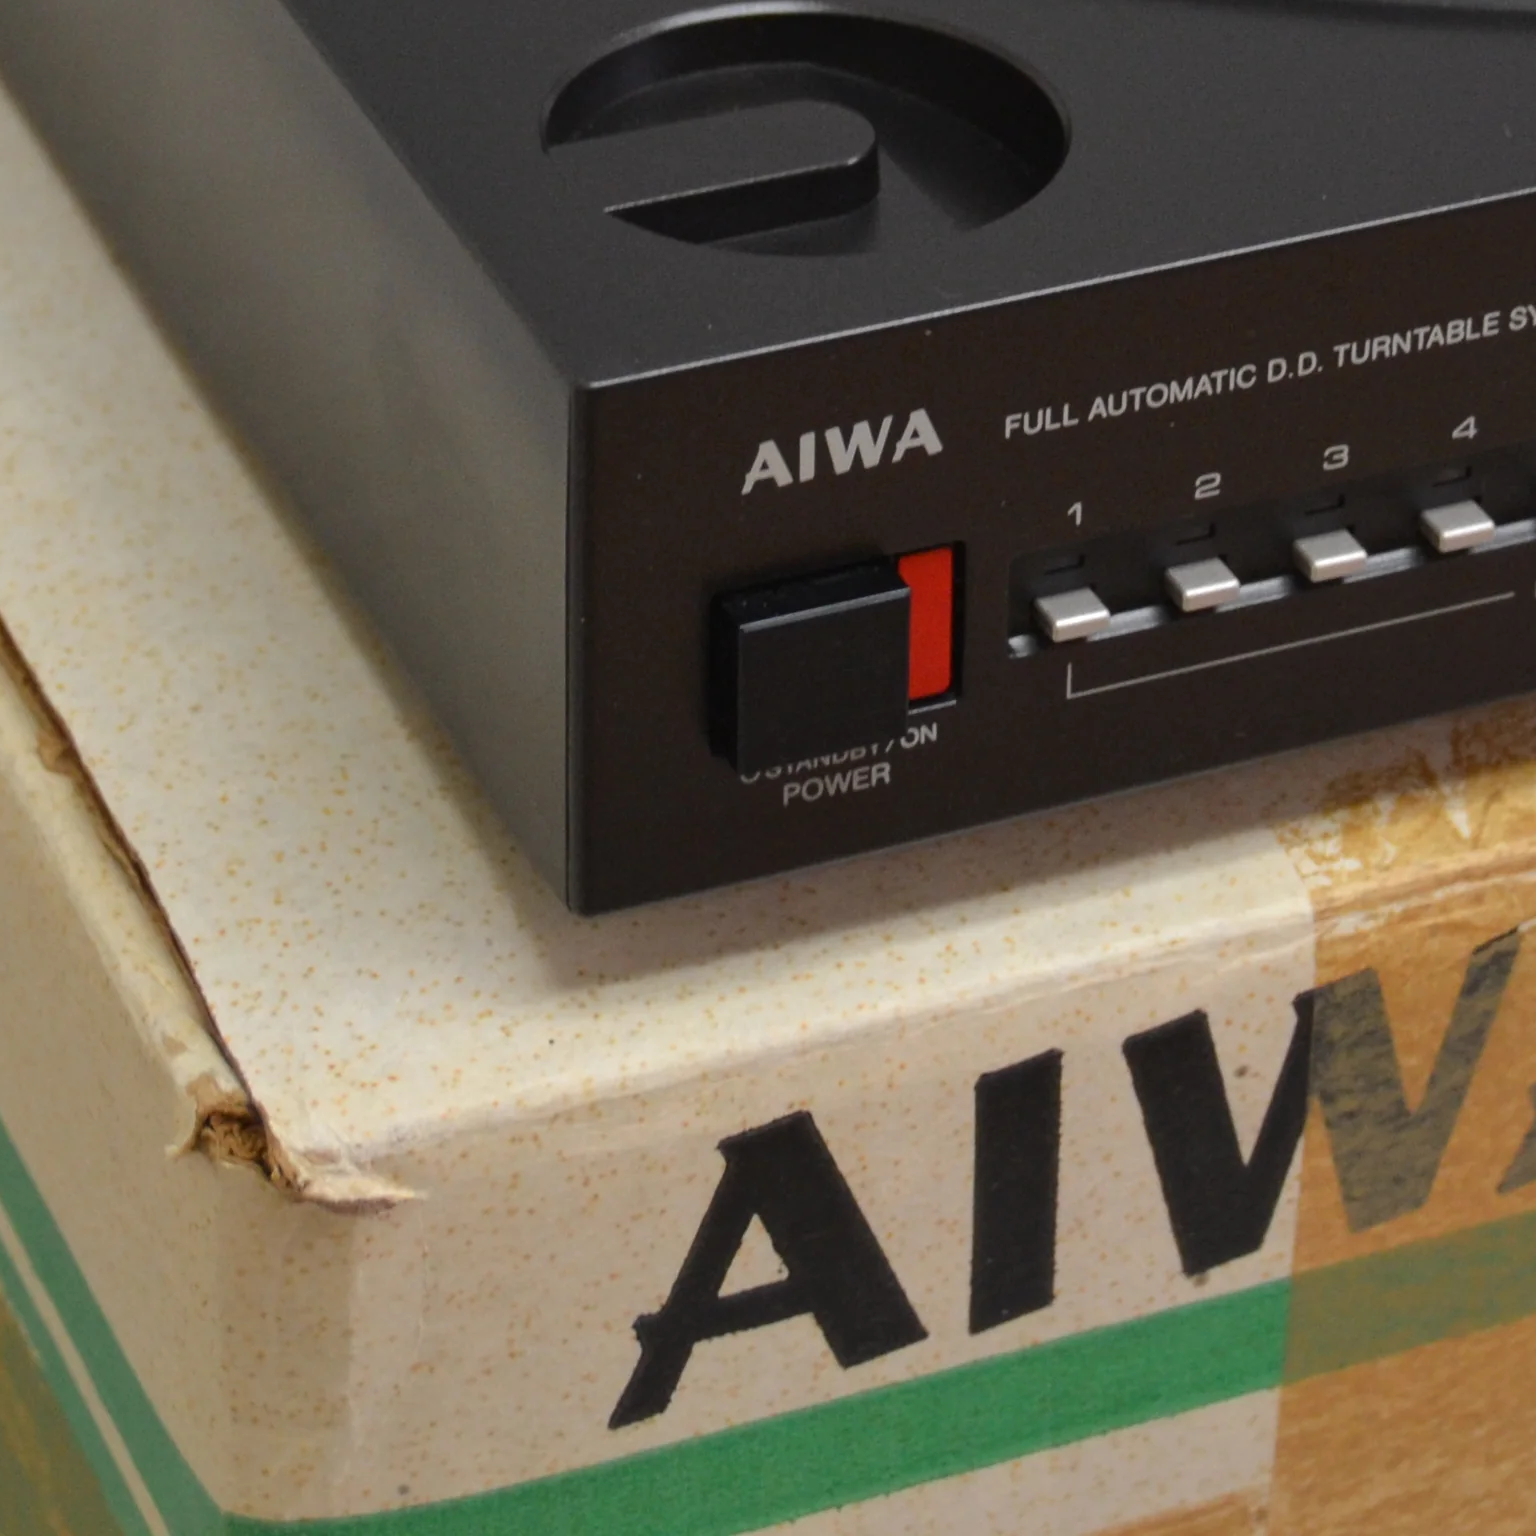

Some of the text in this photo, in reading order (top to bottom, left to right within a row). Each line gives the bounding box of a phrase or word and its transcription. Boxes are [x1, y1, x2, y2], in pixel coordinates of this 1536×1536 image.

[1005, 403, 1078, 439] FULL
[1087, 363, 1256, 422] AUTOMATIC
[1267, 351, 1323, 382] D.D.
[1333, 311, 1500, 368] TURNTABLE
[1451, 415, 1477, 440] 4
[741, 408, 944, 496] AIWA
[1322, 444, 1349, 470] 3
[1194, 473, 1221, 499] 2
[1067, 502, 1082, 525] 1
[783, 762, 892, 808] POWER
